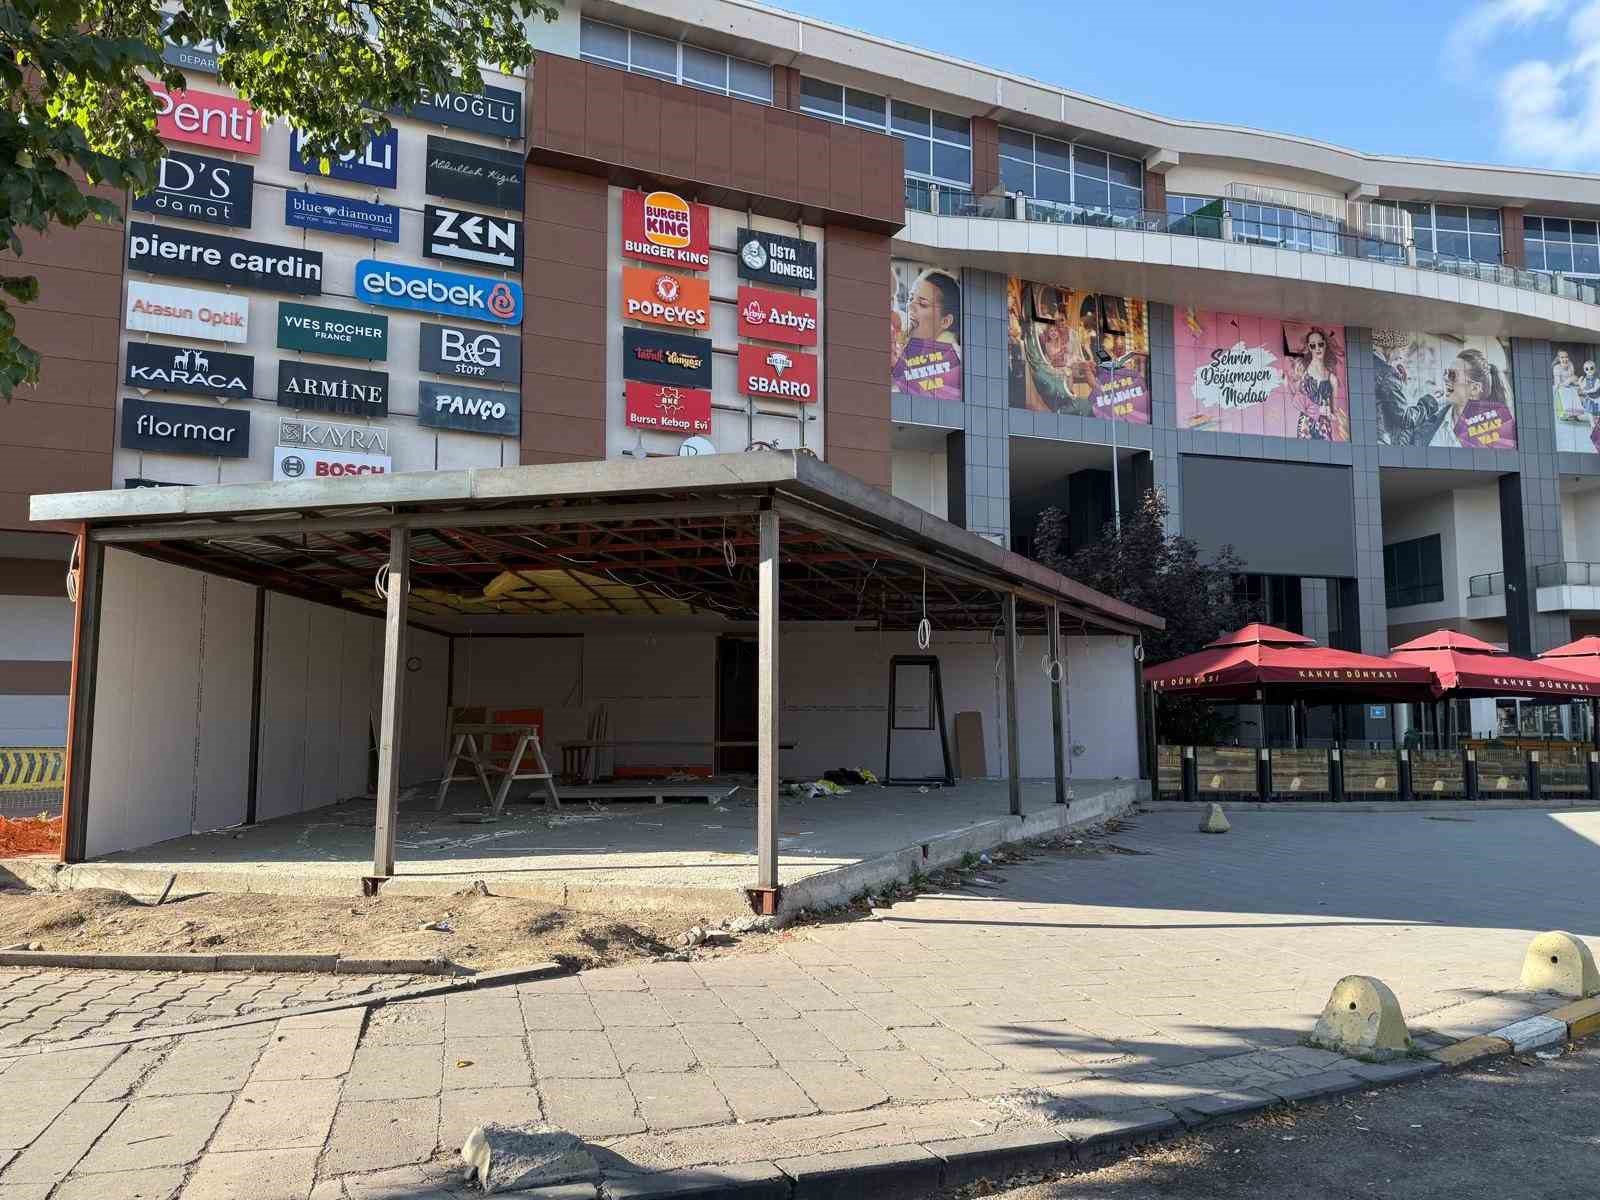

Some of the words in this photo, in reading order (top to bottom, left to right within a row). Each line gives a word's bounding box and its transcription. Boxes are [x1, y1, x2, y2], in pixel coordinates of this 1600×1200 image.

[414, 88, 515, 123] EMOĞLU
[158, 157, 231, 199] D'S
[155, 195, 231, 219] damat
[293, 198, 321, 213] blue
[337, 206, 393, 225] diamond
[646, 206, 688, 222] BURGER
[432, 209, 516, 249] ZEN
[646, 217, 688, 238] KING
[130, 234, 222, 266] pierre
[230, 250, 321, 281] cardin
[625, 240, 675, 260] BURGER
[677, 250, 709, 265] KING
[769, 243, 796, 261] USTA
[363, 272, 485, 309] ebebek
[132, 299, 193, 320] Atasun
[197, 307, 246, 328] Optik
[769, 308, 816, 332] Arby's
[285, 316, 320, 331] YVES
[325, 322, 382, 339] ROCHER
[315, 331, 352, 343] FRANCE
[441, 329, 501, 368] B&G
[131, 365, 248, 391] KARACA
[455, 363, 487, 377] store
[285, 377, 382, 403] ARMİNE
[748, 376, 811, 398] SBARRO
[1222, 387, 1268, 407] Modası
[436, 395, 506, 420] PANÇO
[137, 415, 236, 442] flormar
[630, 413, 657, 425] Bursa
[661, 416, 690, 430] Kebap
[694, 420, 708, 430] Evi
[303, 424, 385, 450] KAYRA
[1299, 670, 1340, 679] KAHVE
[1346, 669, 1398, 678] DÜNYASI
[1493, 677, 1533, 687] KAHVE
[1539, 680, 1589, 691] DÜNYASI
